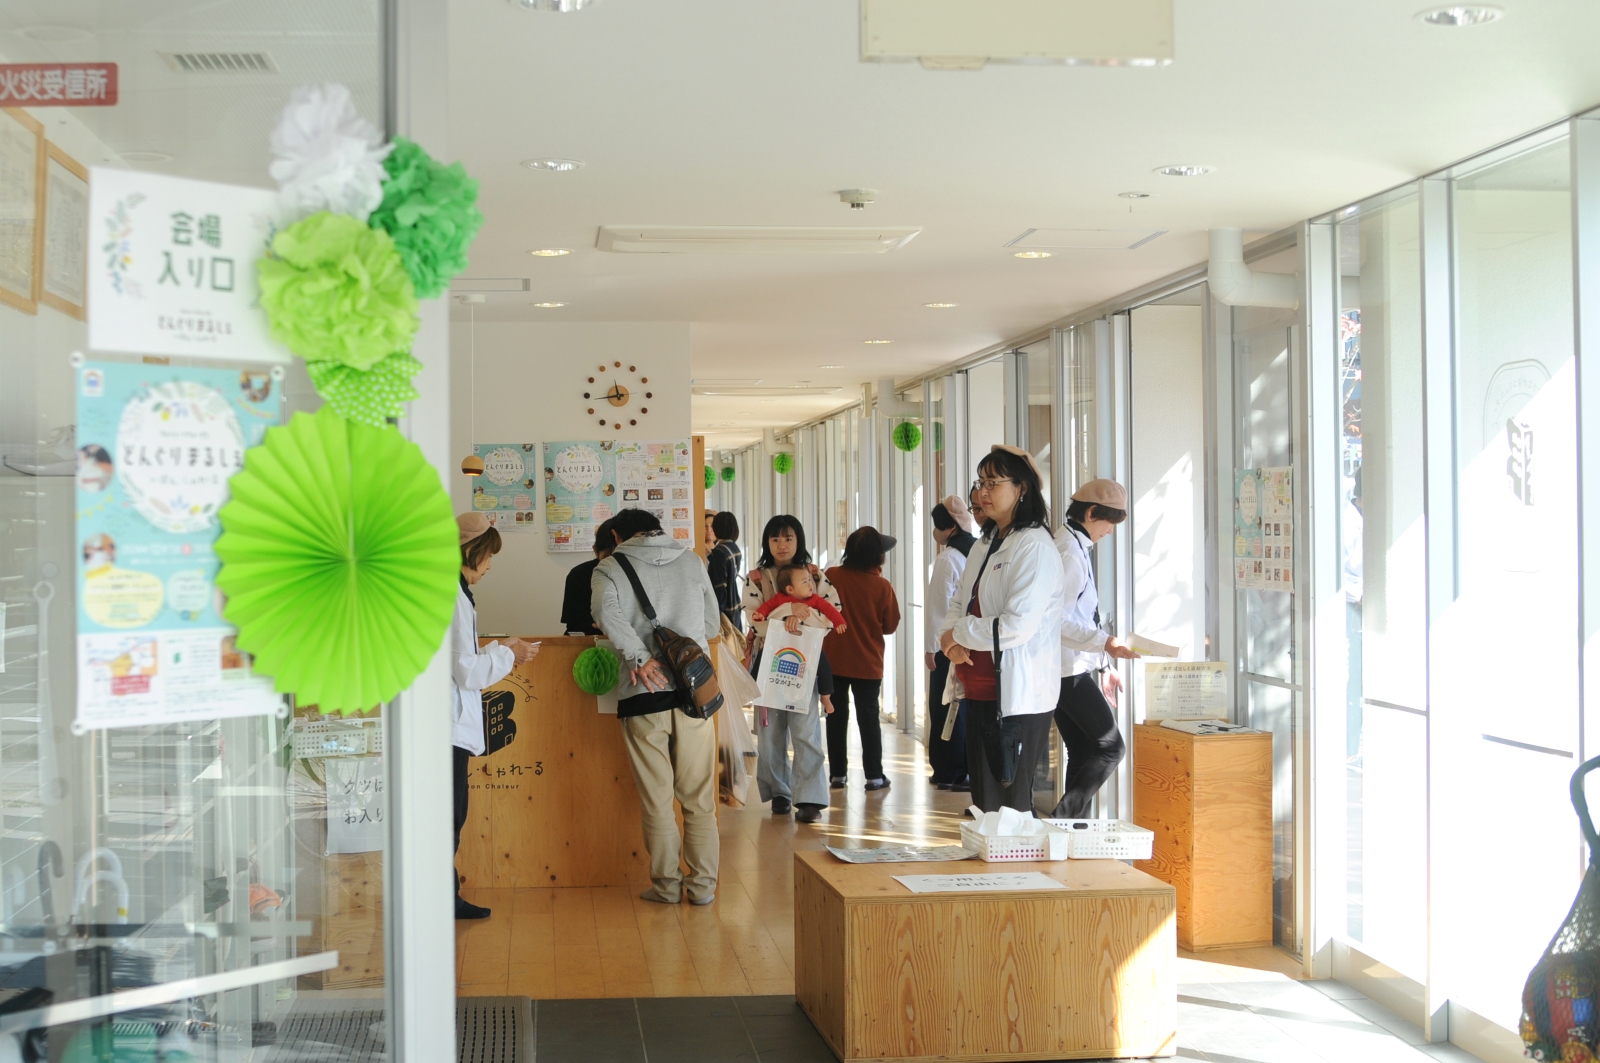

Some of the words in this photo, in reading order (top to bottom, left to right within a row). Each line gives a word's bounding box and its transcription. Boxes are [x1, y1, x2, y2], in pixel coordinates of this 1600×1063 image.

[0, 69, 108, 100] 火災受信所
[170, 211, 222, 248] 会場
[157, 250, 235, 293] 入り口
[123, 444, 244, 468] どんぐりまるしぇ
[769, 677, 801, 688] つながるーむ
